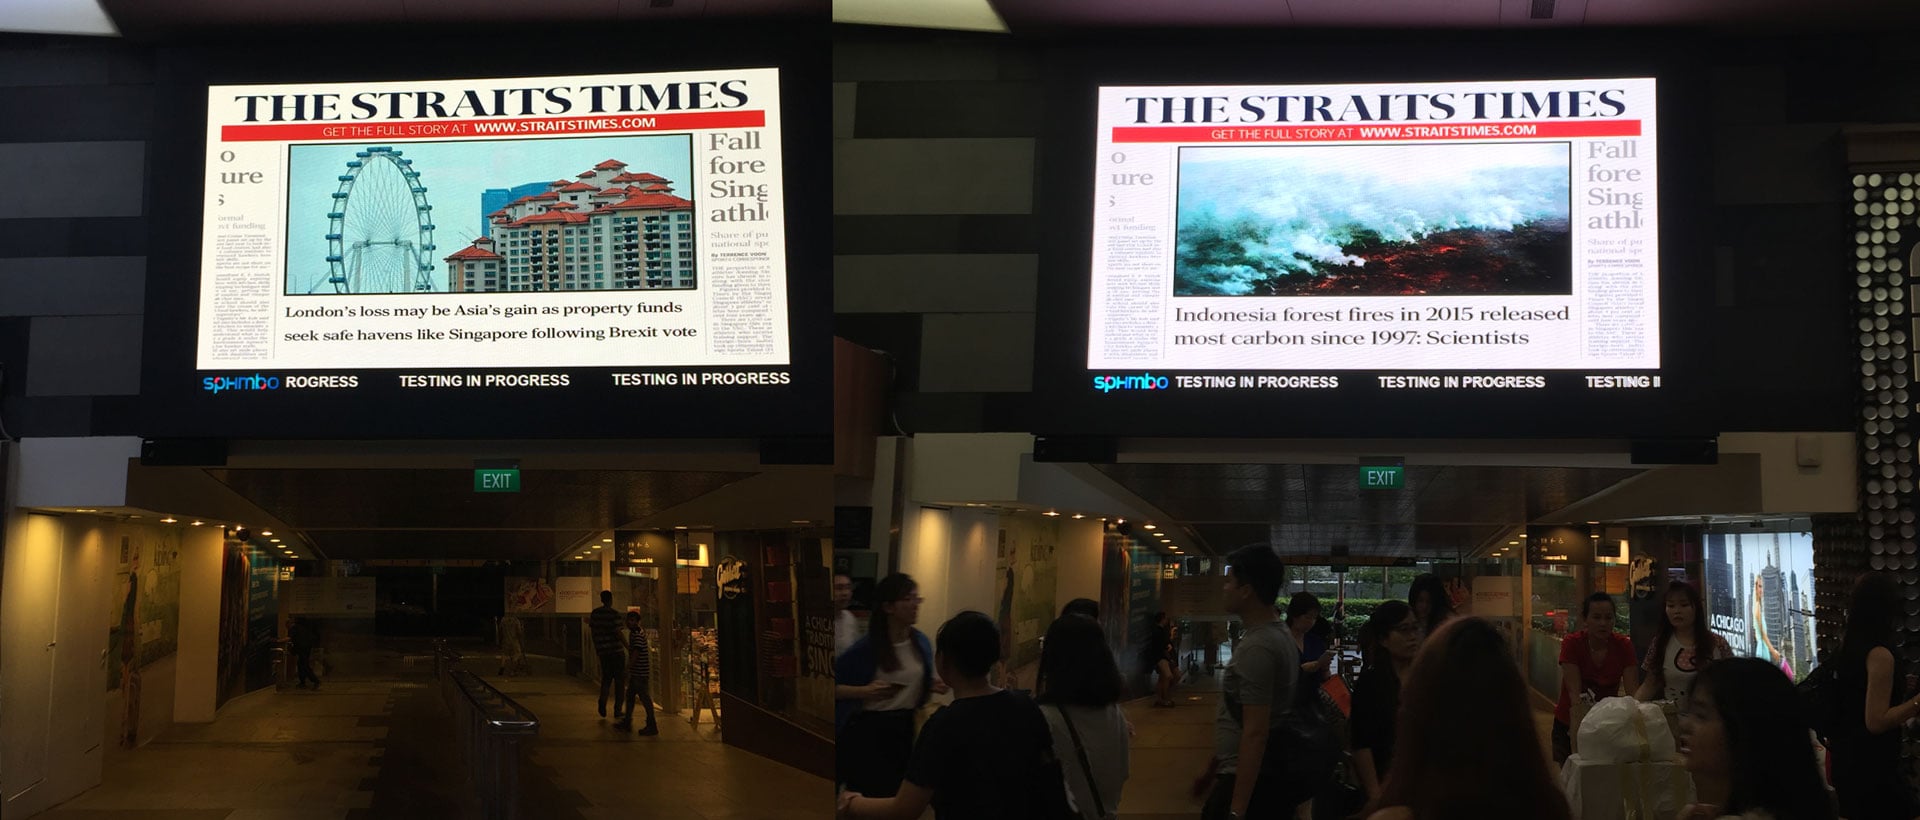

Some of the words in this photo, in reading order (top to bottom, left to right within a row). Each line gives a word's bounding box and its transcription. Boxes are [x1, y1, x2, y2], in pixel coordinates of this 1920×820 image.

[235, 95, 341, 122] THE
[352, 87, 572, 119] STRAITS
[580, 80, 748, 113] TIMES
[1125, 97, 1229, 123] THE
[1240, 93, 1456, 122] STRAITS
[1464, 89, 1626, 119] TIMES
[323, 127, 346, 137] GET
[350, 126, 373, 136] THE
[377, 125, 405, 135] FULL
[409, 123, 448, 135] STORY
[452, 123, 467, 133] AT
[474, 117, 656, 133] WWW.STRAITSTIMES.COM
[1212, 129, 1235, 140] GET
[1239, 129, 1261, 139] THE
[1265, 128, 1292, 139] FULL
[1296, 127, 1334, 138] STORY
[1337, 127, 1352, 137] AT
[1360, 124, 1537, 138] WWW.STRAITSTIMES.COM
[709, 131, 761, 151] Fall
[1588, 140, 1637, 159] Fall
[709, 156, 765, 174] fore
[1588, 164, 1641, 182] fore
[220, 170, 263, 184] ure
[1111, 172, 1153, 186] ure
[710, 180, 768, 202] Sing
[1588, 187, 1643, 209] Sing
[711, 203, 769, 223] athl
[1588, 210, 1643, 229] athl
[711, 240, 751, 248] national
[360, 306, 391, 318] loss
[394, 305, 430, 319] may
[432, 304, 451, 317] be
[504, 304, 538, 318] gain
[542, 305, 560, 315] as
[563, 302, 633, 317] property
[637, 301, 683, 314] funds
[1175, 307, 1276, 322] Indonesia
[1283, 307, 1342, 321] forest
[1349, 307, 1394, 321] fires
[1400, 307, 1420, 321] in
[1426, 307, 1473, 321] 2015
[1480, 305, 1570, 321] released
[284, 329, 319, 341] seek
[323, 329, 354, 341] safe
[357, 328, 413, 341] havens
[417, 328, 444, 340] like
[448, 326, 528, 342] Singapore
[531, 326, 605, 341] following
[608, 325, 659, 339] Brexit
[663, 327, 697, 338] vote
[1175, 332, 1226, 345] most
[1231, 330, 1304, 345] carbon
[1311, 331, 1364, 345] since
[1371, 330, 1421, 345] 1997:
[1426, 330, 1530, 345] Scientists
[286, 376, 359, 388] ROGRESS
[399, 375, 463, 387] TESTING
[466, 375, 482, 387] IN
[486, 374, 570, 386] PROGRESS
[612, 373, 678, 386] TESTING
[682, 373, 697, 385] IN
[702, 372, 790, 385] PROGRESS
[1176, 375, 1236, 388] TESTING
[1240, 375, 1254, 388] IN
[1258, 375, 1339, 388] PROGRESS
[1379, 376, 1440, 388] TESTING
[1444, 376, 1459, 388] IN
[1463, 375, 1546, 388] PROGRESS
[1585, 375, 1650, 388] TESTING
[483, 473, 512, 489] EXIT
[1368, 470, 1396, 486] EXIT
[1716, 614, 1745, 632] CHICAGO
